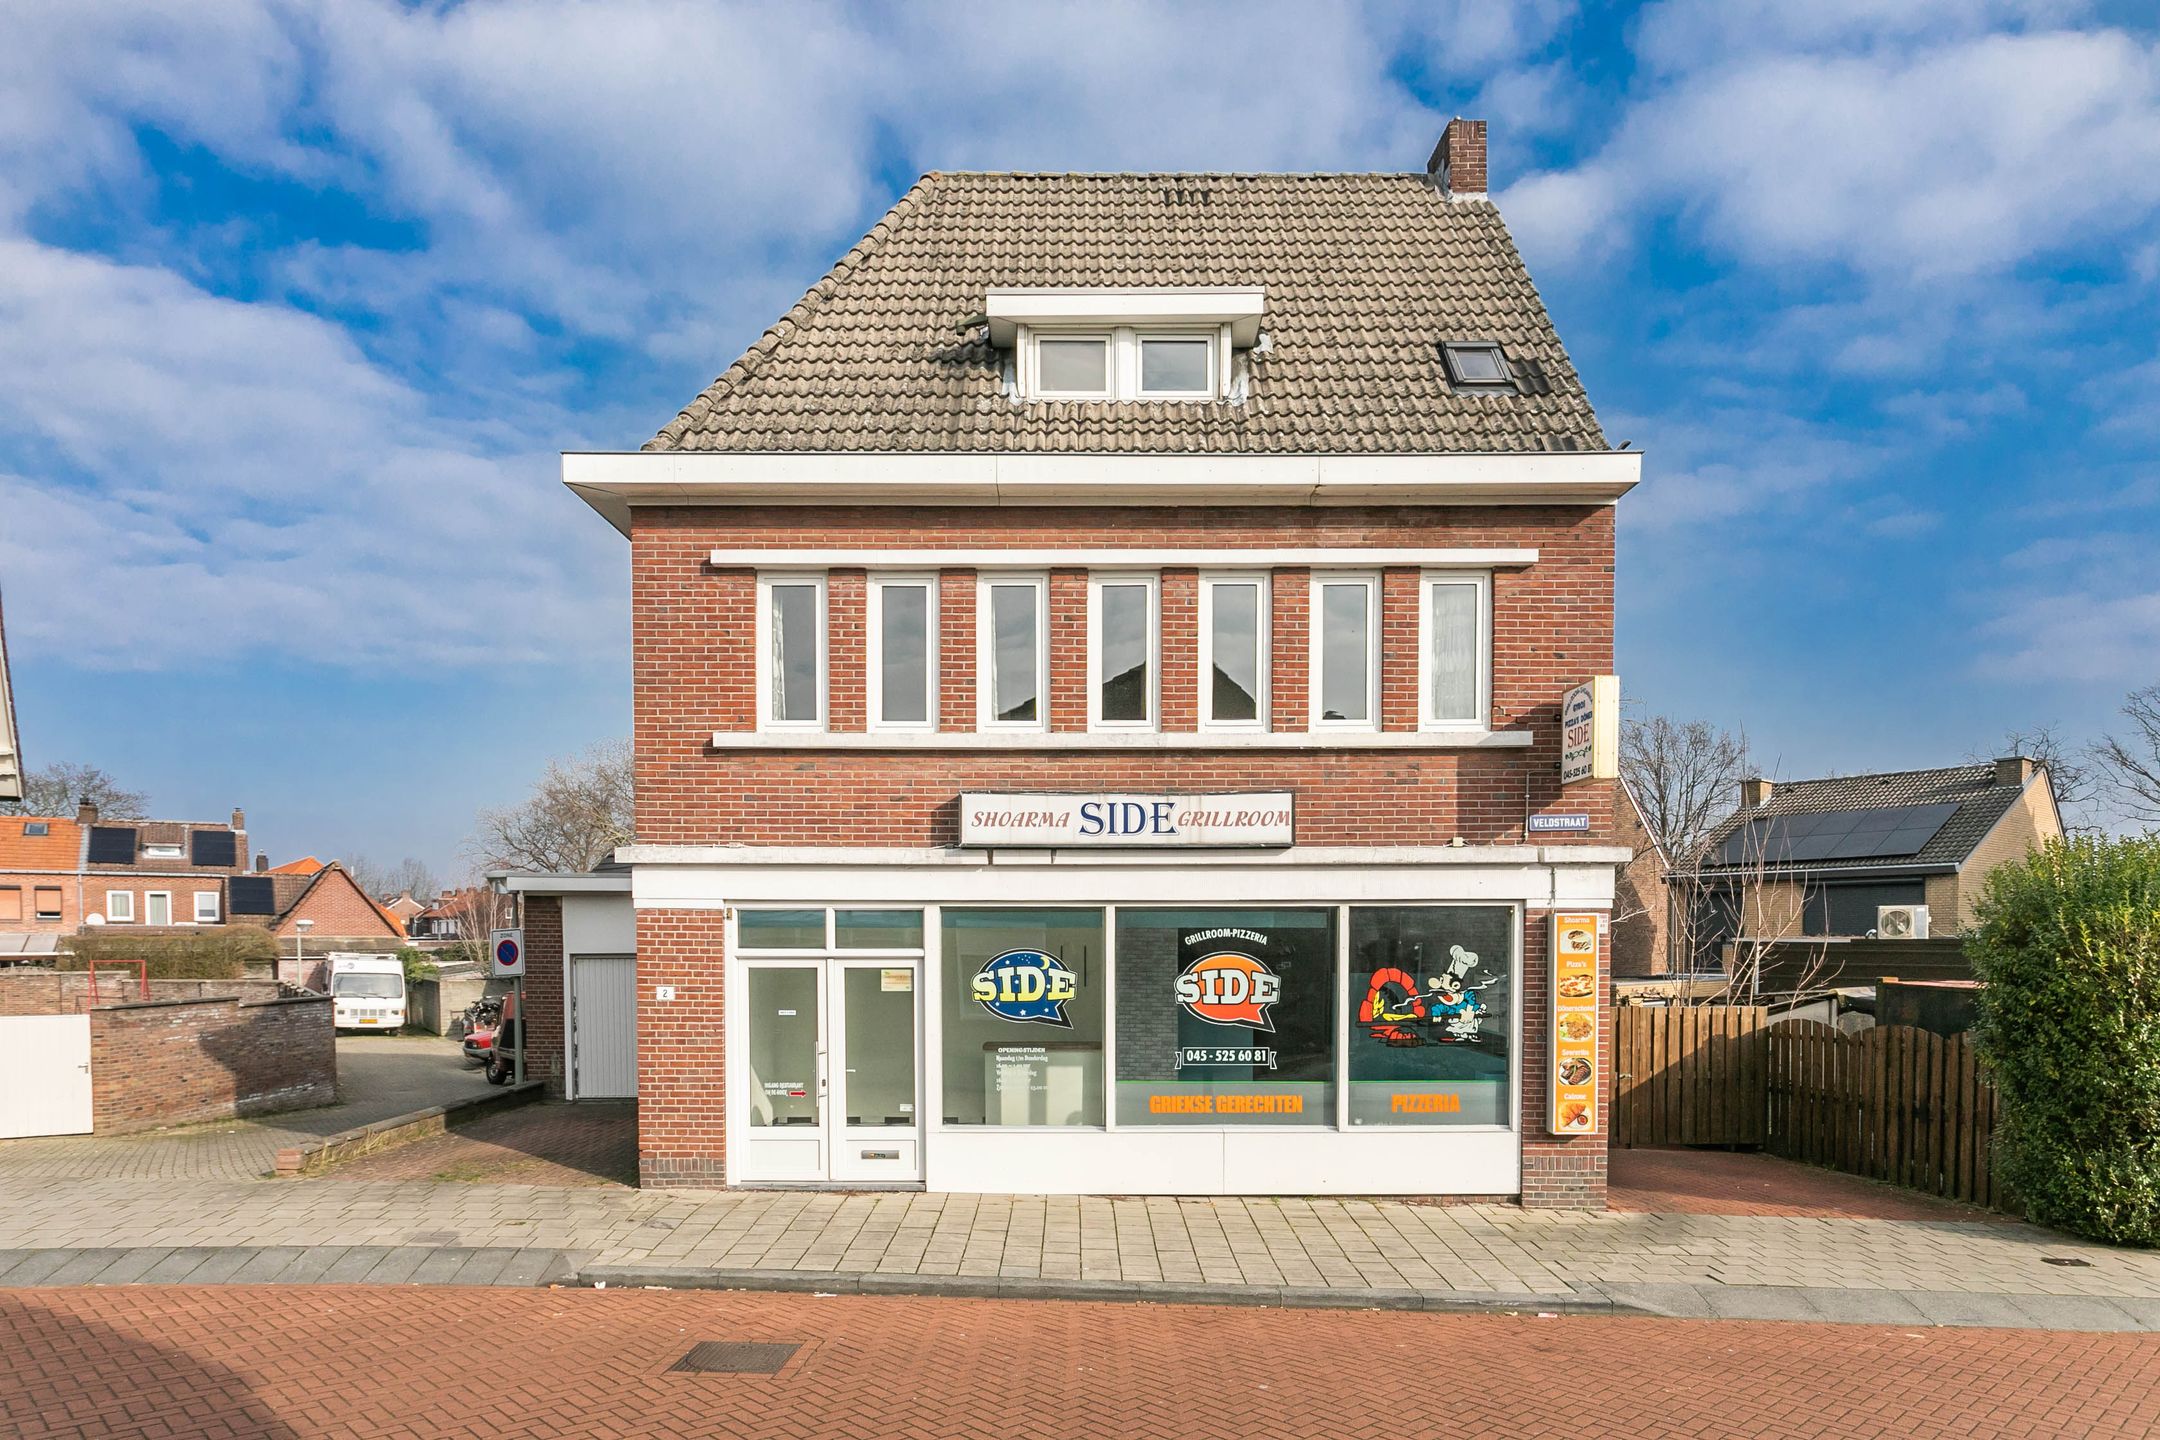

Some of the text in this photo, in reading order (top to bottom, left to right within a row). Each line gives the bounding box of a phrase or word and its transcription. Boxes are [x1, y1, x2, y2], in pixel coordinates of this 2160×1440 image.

[1567, 722, 1590, 748] SIDE
[971, 801, 1291, 836] SHOARMA SIDE GRILLROOM
[1532, 817, 1586, 828] VELDSTRAAT
[1184, 928, 1268, 946] GRILLROOM-PIZZERIA
[662, 989, 668, 998] 2
[972, 966, 1077, 1002] SIDE
[1175, 968, 1280, 1005] SIDE
[1186, 1050, 1207, 1062] 045
[1215, 1050, 1235, 1062] 525
[1238, 1050, 1252, 1062] 60
[1254, 1050, 1266, 1062] 81
[1149, 1095, 1303, 1113] GRIEKSE GERECHTEN
[1391, 1093, 1461, 1113] PIZZERIA
